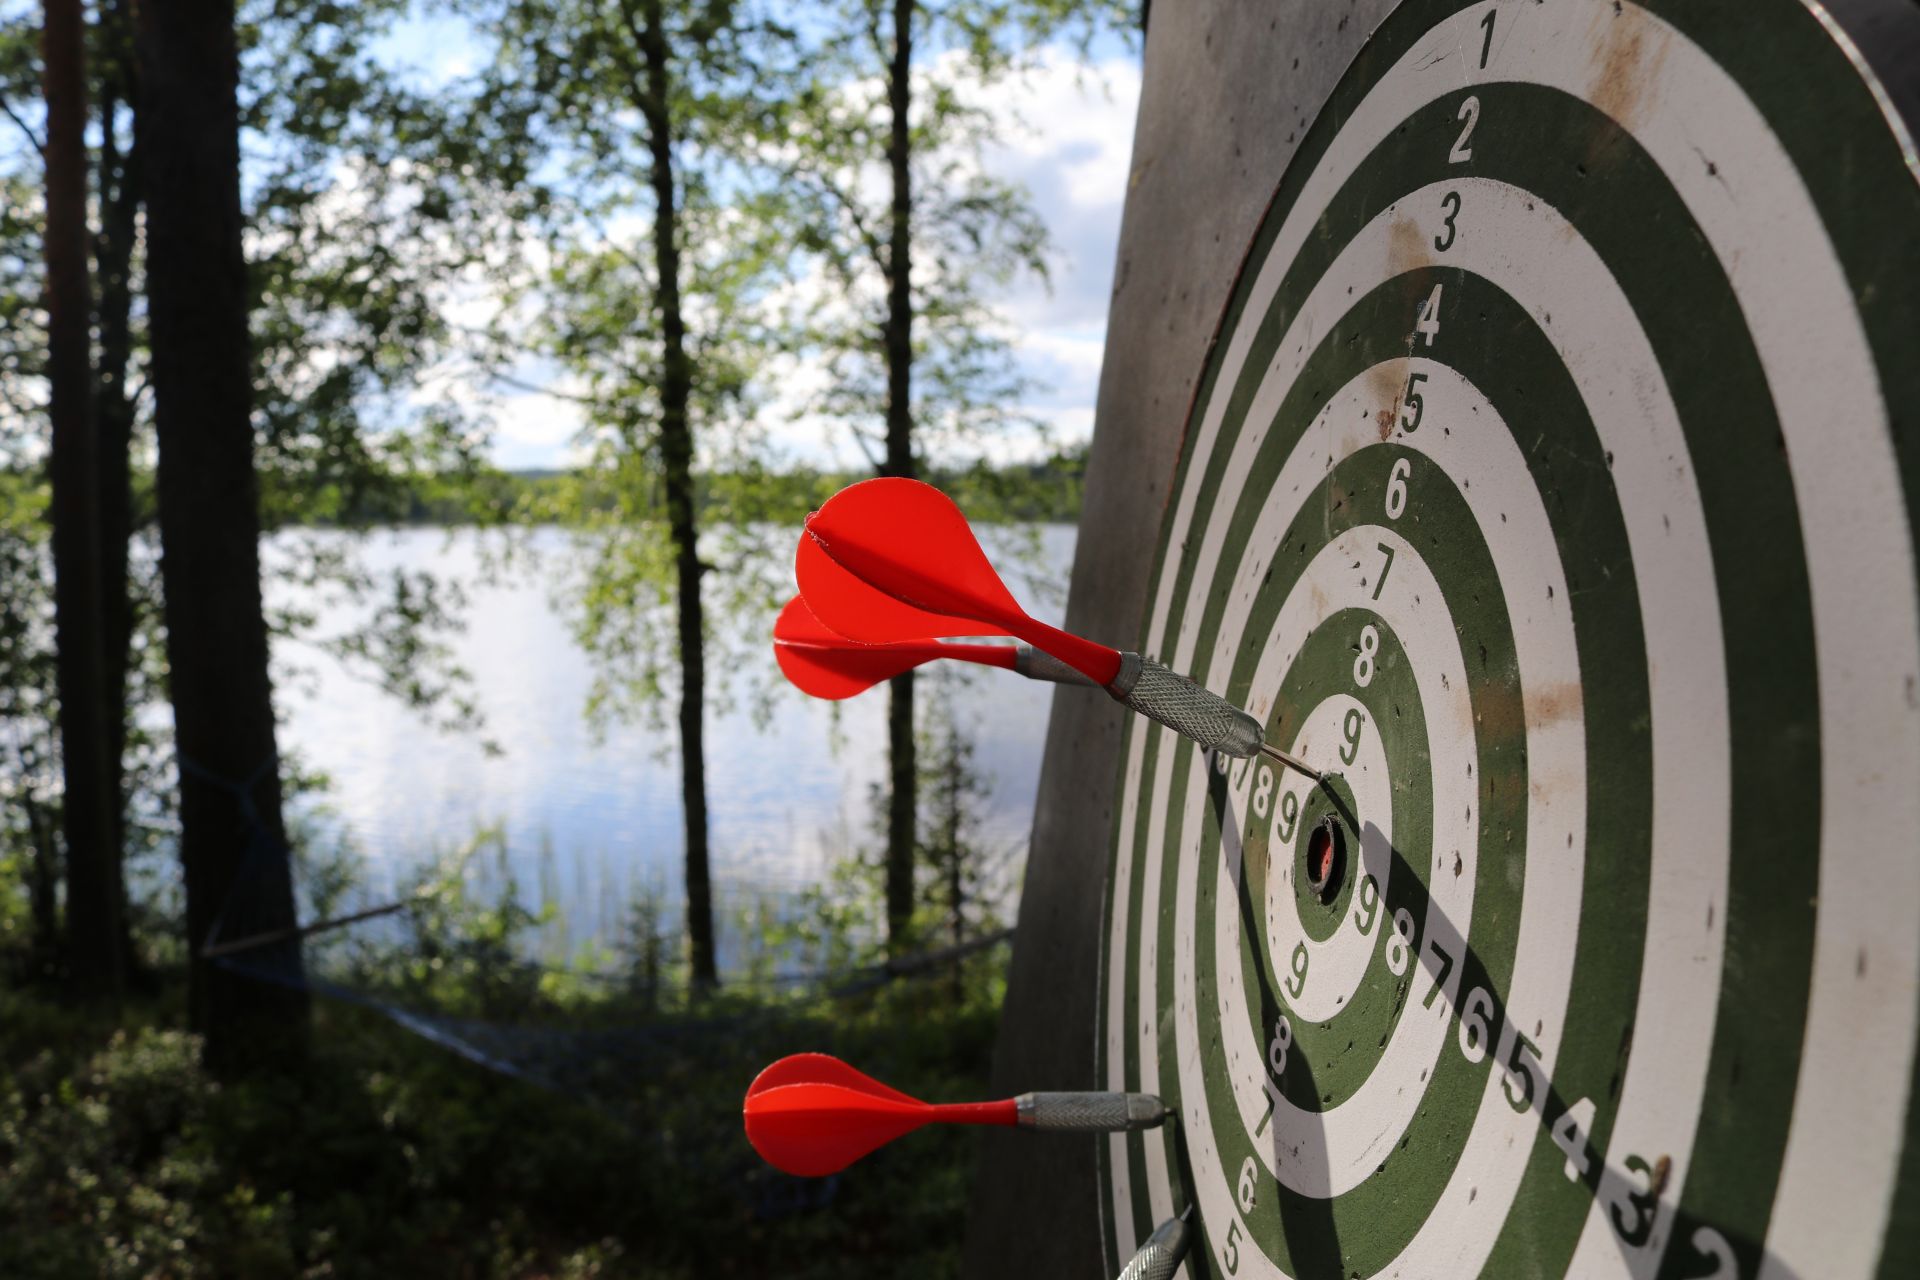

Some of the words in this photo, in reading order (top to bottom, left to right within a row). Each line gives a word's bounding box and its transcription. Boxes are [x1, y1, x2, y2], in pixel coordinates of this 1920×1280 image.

[1480, 9, 1496, 69] 1
[1449, 96, 1480, 163] 2
[1434, 191, 1461, 252] 3
[1417, 284, 1443, 346] 4
[1401, 373, 1428, 433] 5
[1385, 458, 1411, 520] 6
[1371, 542, 1394, 600] 7
[1353, 624, 1379, 687] 8
[1339, 708, 1362, 766] 9
[1253, 765, 1273, 819] 8
[1277, 791, 1298, 844] 9
[1355, 874, 1379, 936] 9
[1287, 944, 1309, 1000] 9
[1386, 907, 1415, 976] 8
[1423, 941, 1453, 1010] 7
[1270, 1015, 1292, 1075] 8
[1459, 986, 1494, 1063] 6
[1502, 1030, 1542, 1113] 5
[1255, 1084, 1275, 1138] 7
[1551, 1097, 1597, 1183] 4
[1238, 1156, 1258, 1214] 6
[1610, 1154, 1656, 1247] 3
[1223, 1218, 1243, 1276] 5
